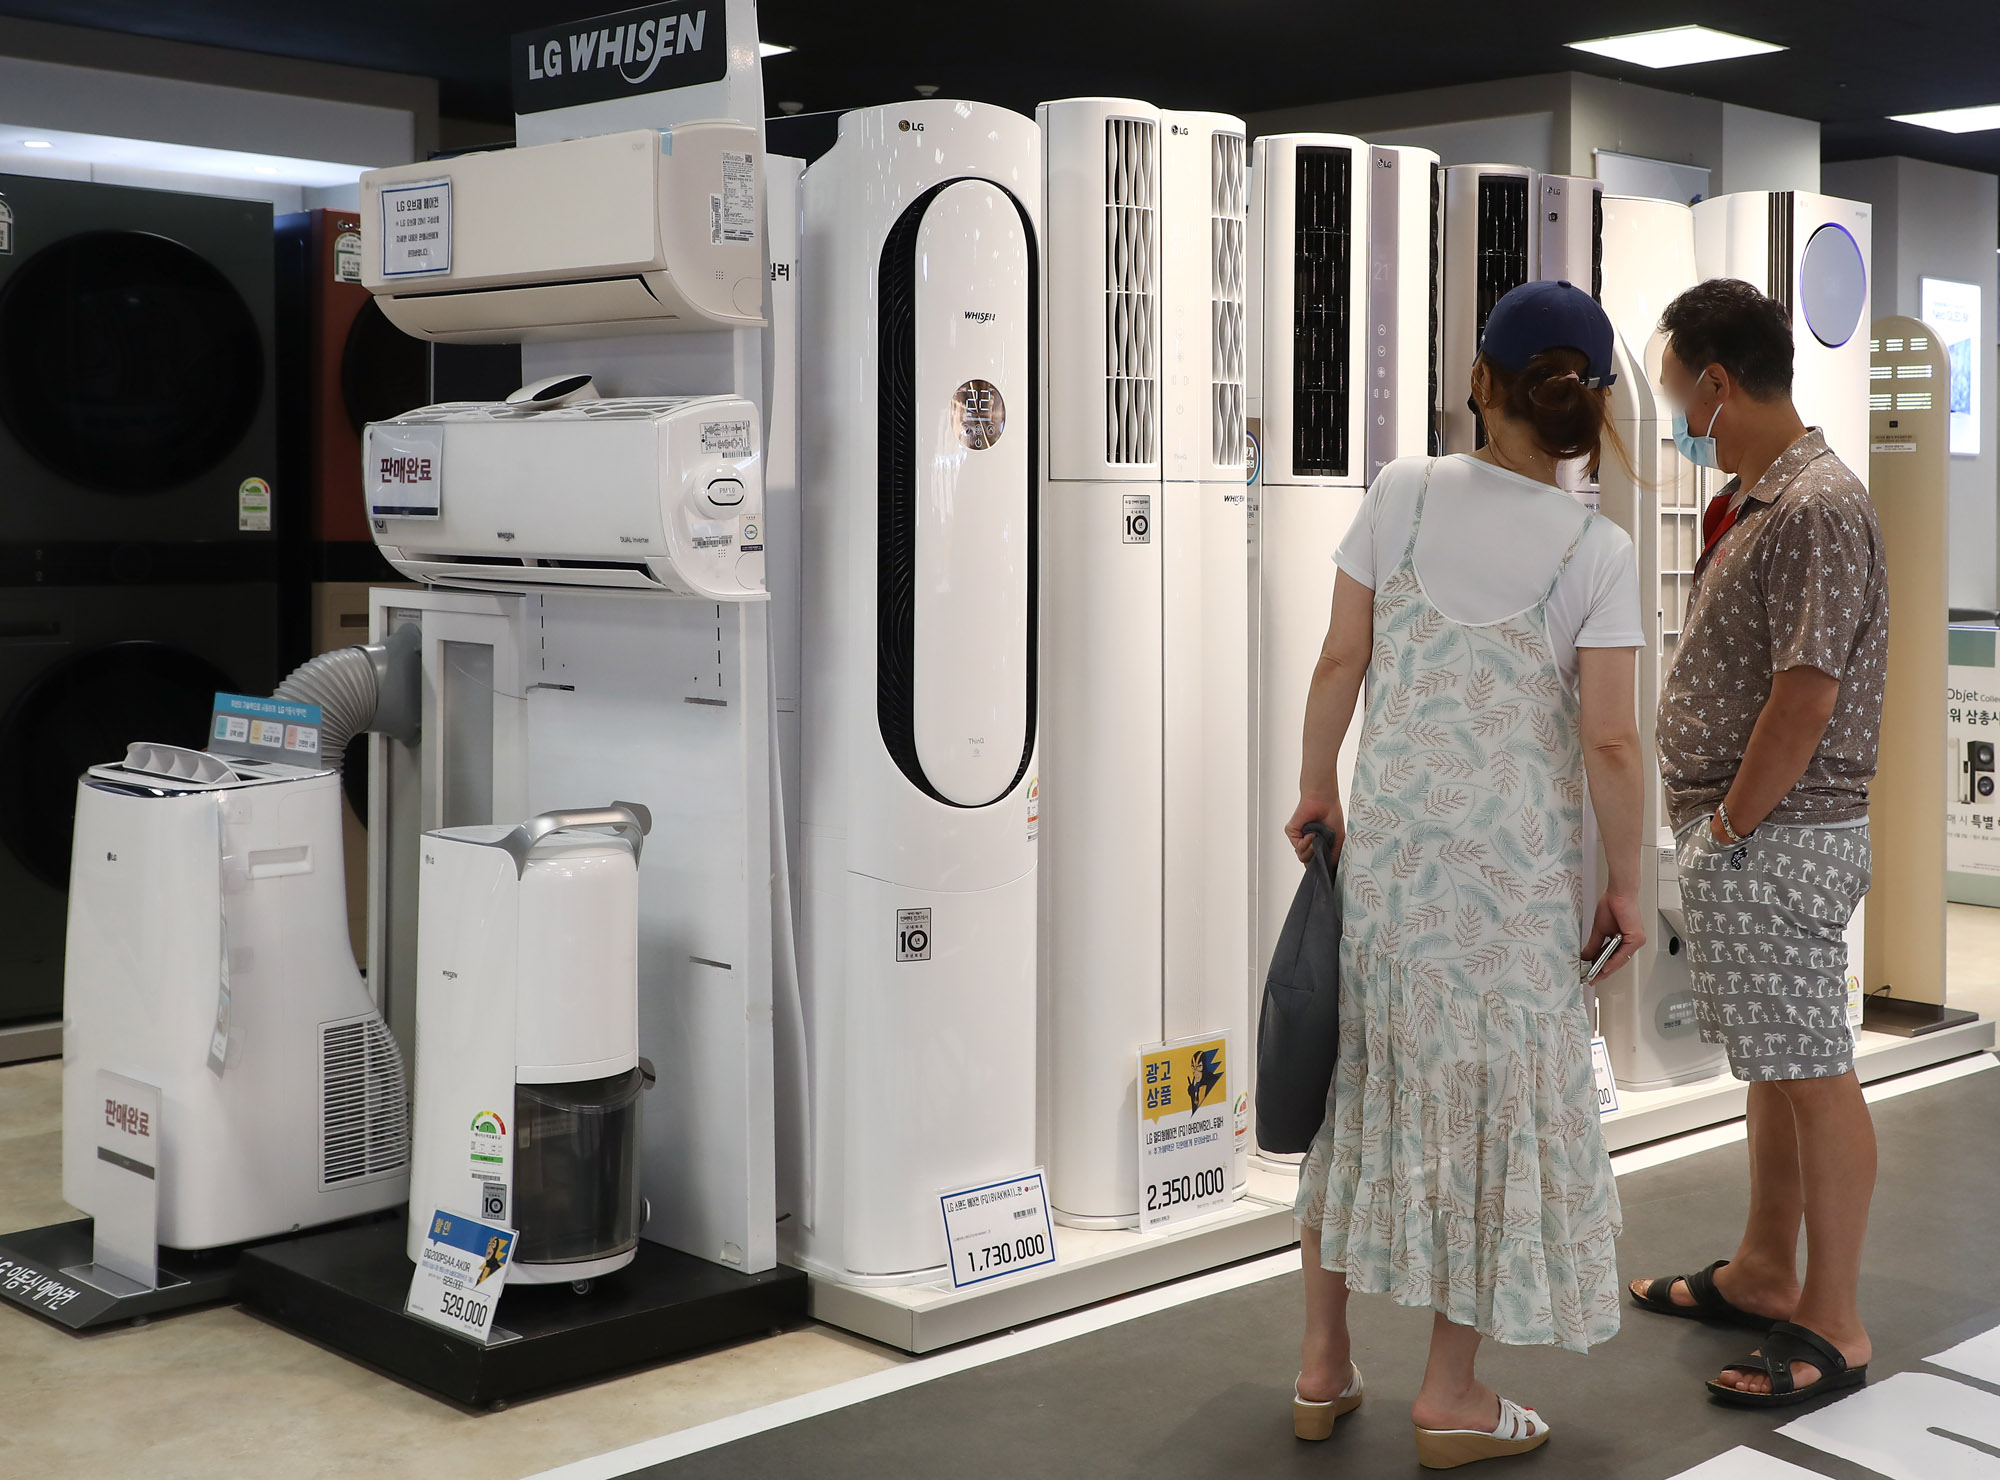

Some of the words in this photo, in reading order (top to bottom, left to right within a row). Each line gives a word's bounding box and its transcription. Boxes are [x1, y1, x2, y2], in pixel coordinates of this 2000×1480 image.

[528, 40, 562, 80] LG
[569, 10, 706, 84] WHISEN
[912, 122, 924, 131] LG
[1383, 160, 1392, 168] LG
[396, 200, 405, 212] LG
[380, 456, 432, 484] 판매완료
[1947, 688, 1978, 703] Objet
[1947, 708, 1961, 723] 워
[1971, 814, 1993, 830] 특별
[900, 929, 928, 952] 10
[1146, 1060, 1171, 1084] 광고
[1146, 1085, 1172, 1109] 상품
[104, 1099, 150, 1137] 판매완료
[1147, 1166, 1224, 1211] 2,350,000
[968, 1234, 1045, 1272] 1,730,000
[440, 1291, 488, 1327] 529,000
